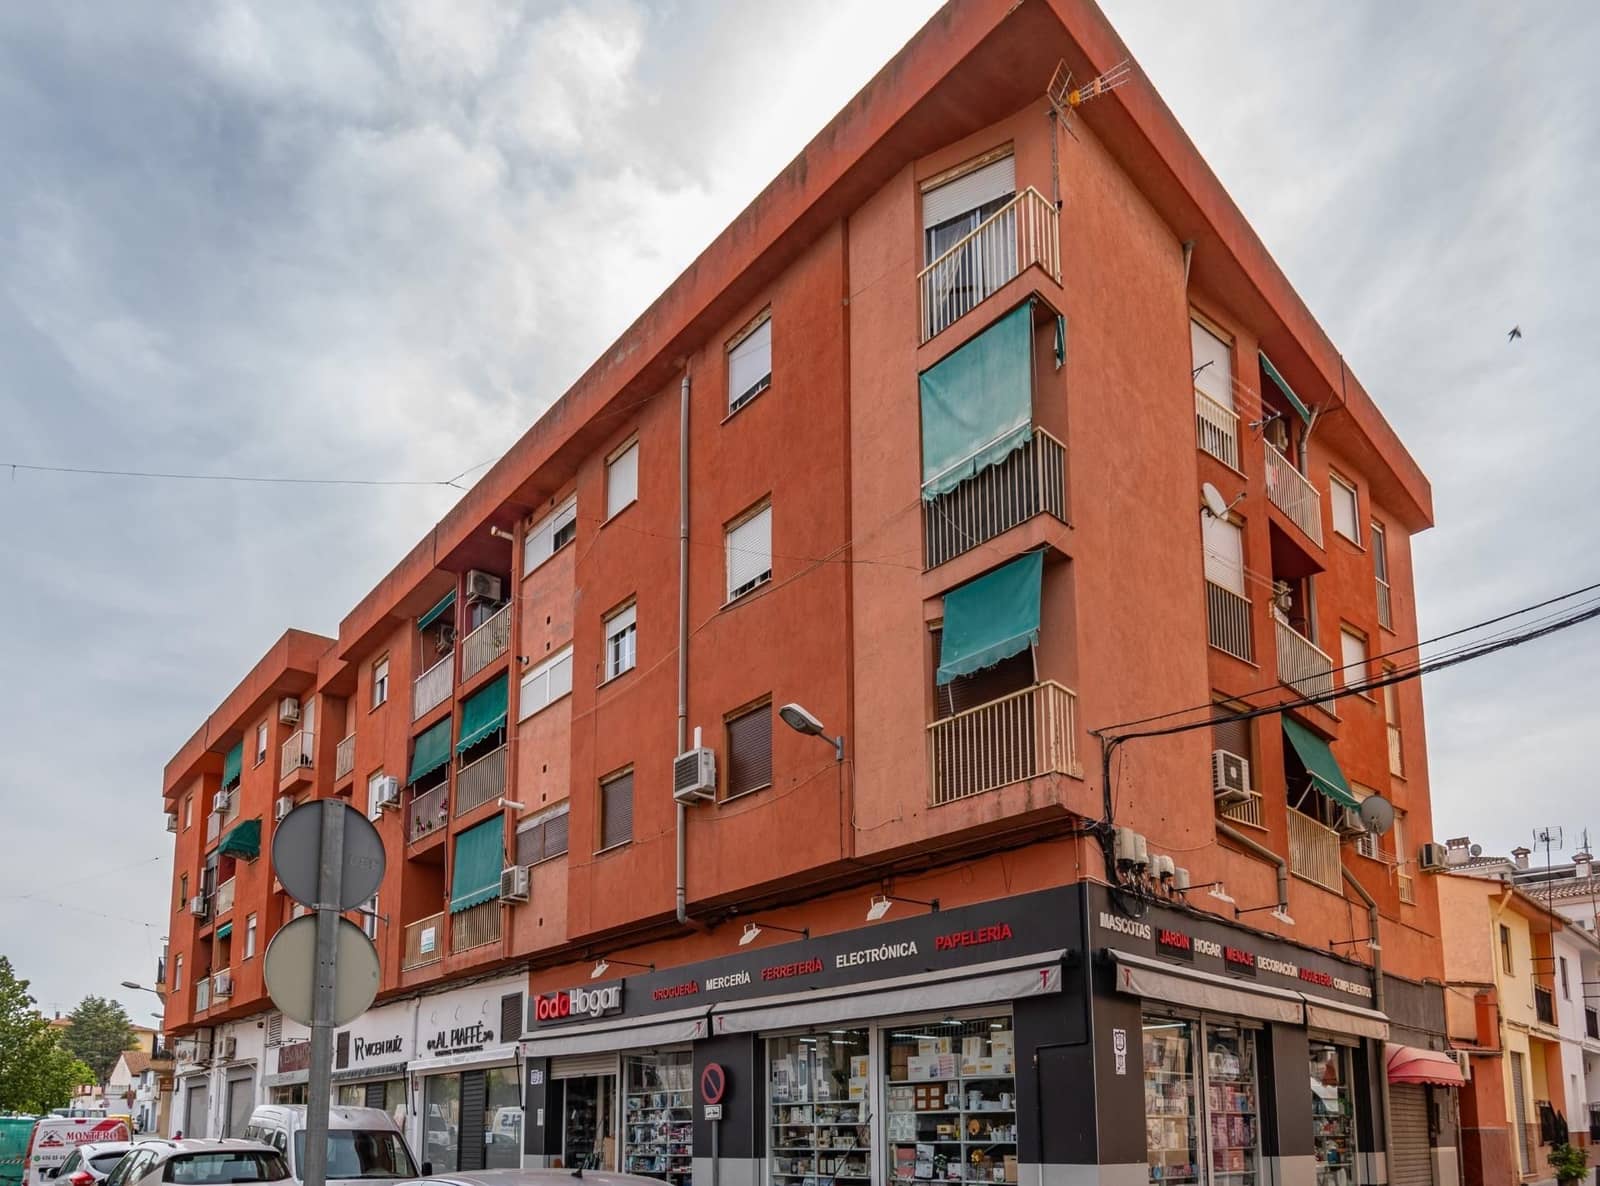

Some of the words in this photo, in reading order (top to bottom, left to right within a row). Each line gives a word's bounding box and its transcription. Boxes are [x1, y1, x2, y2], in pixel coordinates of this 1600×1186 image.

[706, 970, 751, 991] MERCERÍA
[760, 955, 824, 981] FERRETERÍA
[836, 941, 918, 968] ELECTRÓNICA
[935, 922, 1013, 951] PAPELERÍA
[1100, 912, 1151, 939] MASCOTAS
[1194, 938, 1221, 957] HOGAR
[1225, 946, 1254, 966] MENAJE
[1257, 955, 1298, 977] DECORACIÓN
[534, 985, 622, 1021] TodoHogar
[66, 1131, 117, 1141] MONTERO
